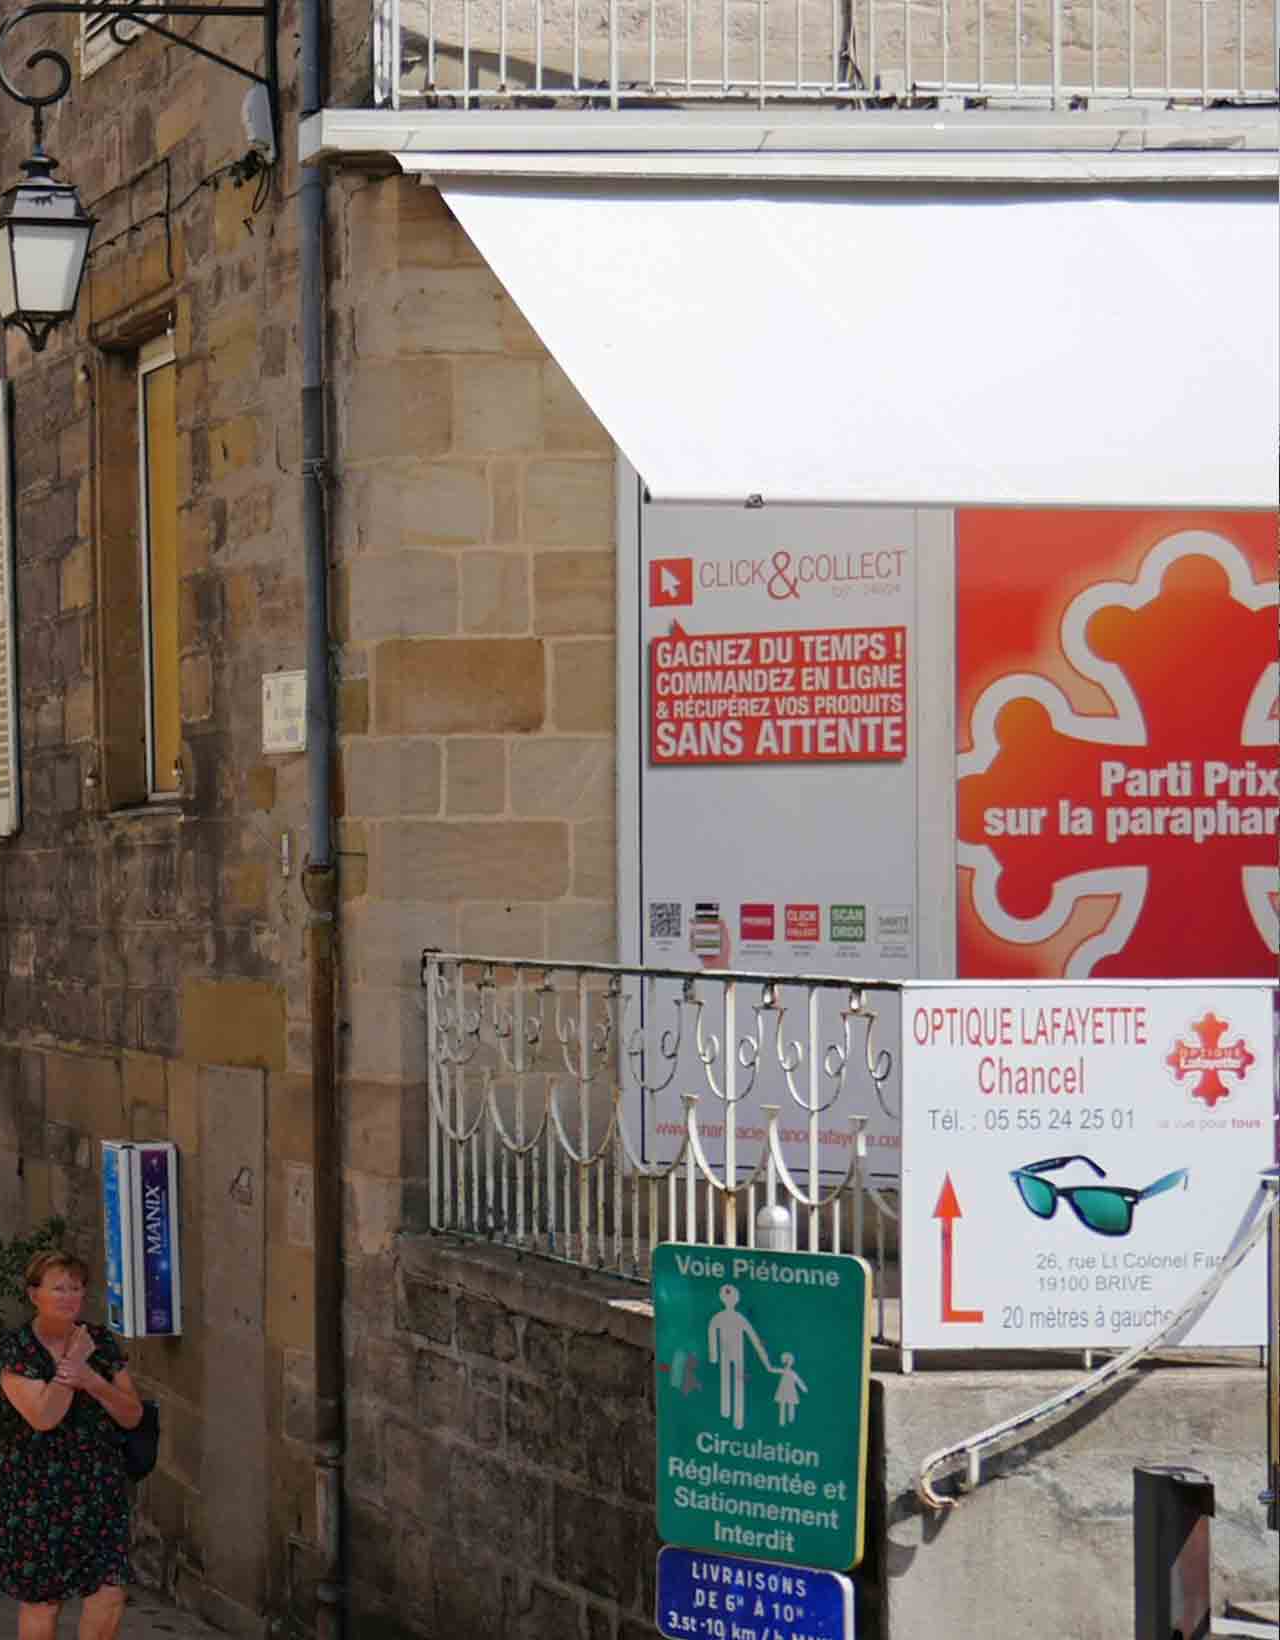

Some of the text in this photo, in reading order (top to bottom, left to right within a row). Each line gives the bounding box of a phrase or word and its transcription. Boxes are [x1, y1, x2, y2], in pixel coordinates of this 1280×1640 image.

[656, 637, 752, 668] GAGNEZ
[758, 635, 793, 664] DU
[799, 633, 886, 662] TEMPS
[656, 663, 903, 696] COMMANDEZ EN LIGNE
[656, 693, 903, 719] & RÉCUPÉREZ VOS PRODUITS
[656, 717, 903, 757] SANS ATTENTE
[1100, 760, 1279, 797] Parti Prix
[983, 800, 1280, 844] sur la paraphar
[913, 1007, 1148, 1047] OPTIQUE LAFAYETTE
[978, 1055, 1085, 1094] Chancel
[928, 1107, 965, 1131] Tél.
[984, 1108, 1009, 1130] 05
[1016, 1108, 1041, 1130] 55
[1048, 1108, 1073, 1130] 24
[1080, 1108, 1105, 1130] 25
[1111, 1108, 1135, 1130] 01
[145, 1184, 162, 1254] MANIX
[675, 1254, 841, 1287] Voie Piétonne
[1036, 1252, 1063, 1271] 26,
[1068, 1254, 1097, 1269] rue
[1101, 1251, 1118, 1269] Lt
[1123, 1250, 1188, 1270] Colonel
[1038, 1275, 1153, 1292] 19100 BRIVE
[1003, 1306, 1024, 1328] 20
[1030, 1304, 1089, 1329] mètres
[1095, 1304, 1106, 1328] à
[696, 1431, 820, 1468] Circulation
[668, 1455, 848, 1502] Réglementée et
[673, 1485, 840, 1530] Stationnement
[714, 1519, 796, 1553] Interdit
[691, 1561, 808, 1599] LIVRAISONS
[694, 1587, 719, 1610] DE
[731, 1621, 757, 1640] km
